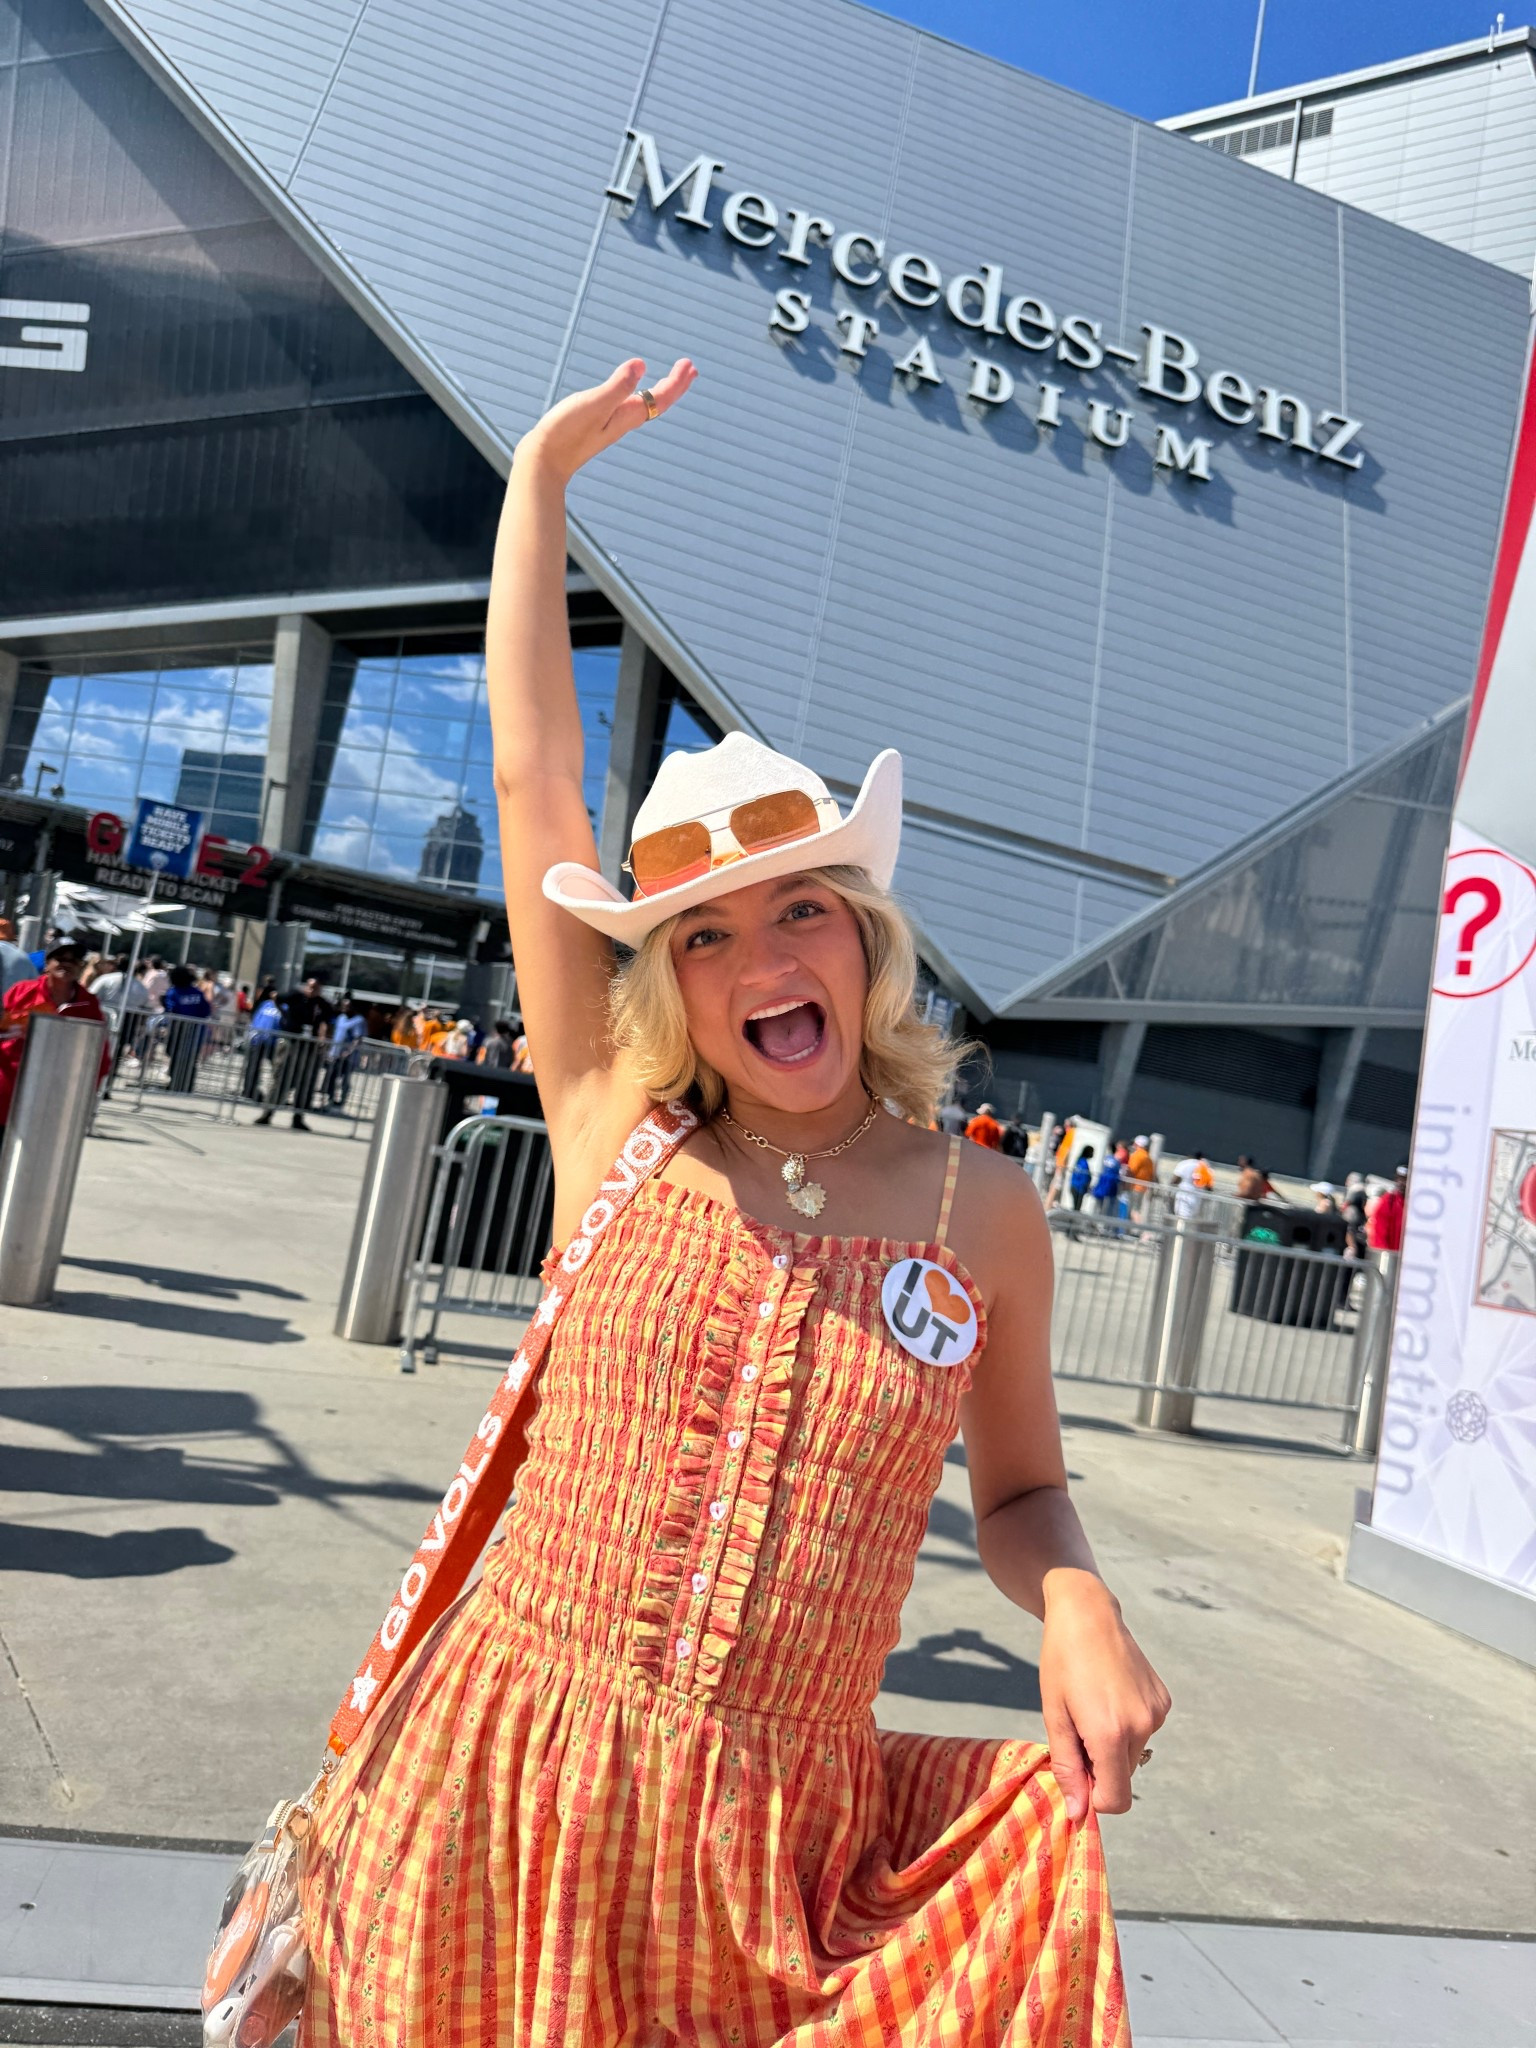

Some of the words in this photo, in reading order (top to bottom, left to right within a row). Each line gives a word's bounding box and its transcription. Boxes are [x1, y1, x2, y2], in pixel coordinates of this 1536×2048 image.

[606, 127, 1365, 470] Mercedes-Benz
[770, 288, 1213, 482] STADIUM
[87, 812, 230, 877] GE
[240, 845, 272, 888] 2
[178, 884, 226, 908] SCAN
[561, 1199, 615, 1273] GO
[600, 1099, 698, 1193] VOLS
[892, 1291, 959, 1360] UT
[902, 1260, 923, 1296] I
[1377, 1101, 1472, 1496] information
[381, 1562, 427, 1651] GO
[420, 1411, 502, 1551] VOLS
